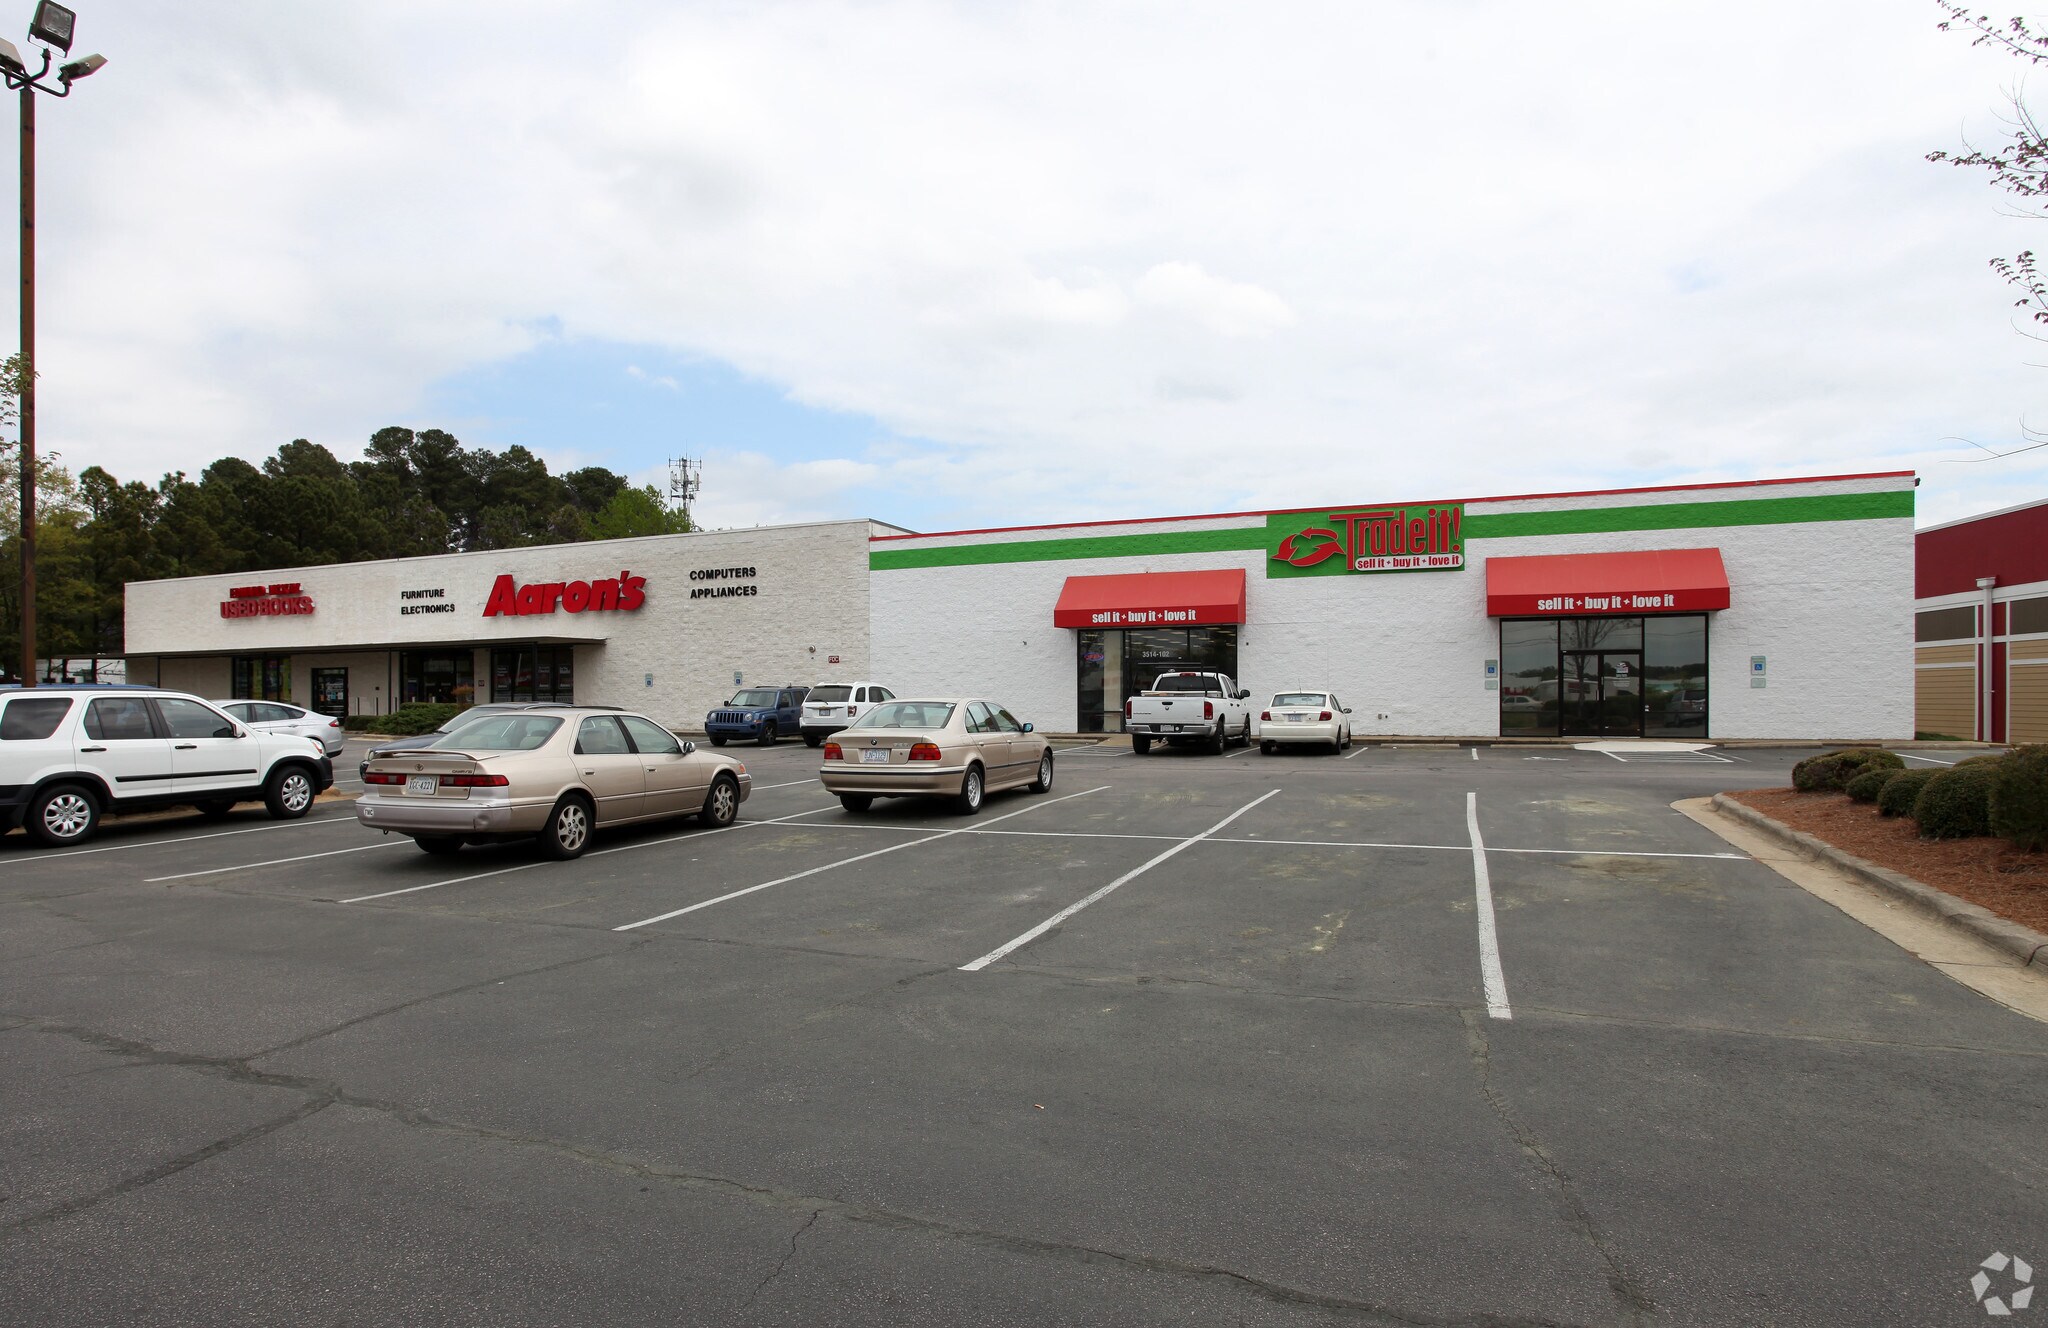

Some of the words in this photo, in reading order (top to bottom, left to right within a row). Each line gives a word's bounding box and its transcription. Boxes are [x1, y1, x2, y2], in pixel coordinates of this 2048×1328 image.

[1357, 558, 1375, 569] sell
[1377, 558, 1385, 568] it
[1393, 557, 1411, 568] buy
[1413, 556, 1420, 567] it
[1428, 556, 1450, 566] love
[1452, 555, 1459, 565] it
[689, 567, 756, 580] COMPUTERS
[401, 589, 445, 600] FURNITURE
[482, 570, 647, 617] Aaron's
[690, 585, 758, 599] APPLIANCES
[221, 600, 258, 619] USED
[259, 596, 315, 616] BOOKS
[401, 603, 455, 615] ELECTRONICS
[1537, 597, 1562, 610] sell
[1564, 597, 1574, 610] it
[1584, 596, 1609, 610] buy
[1611, 595, 1621, 609] it
[1632, 594, 1661, 608] love
[1663, 594, 1674, 607] it
[1092, 612, 1110, 623] sell
[1112, 611, 1120, 623] it
[1128, 611, 1147, 623] buy
[1148, 610, 1156, 622] it
[1164, 610, 1186, 621] love
[1188, 609, 1196, 620] it
